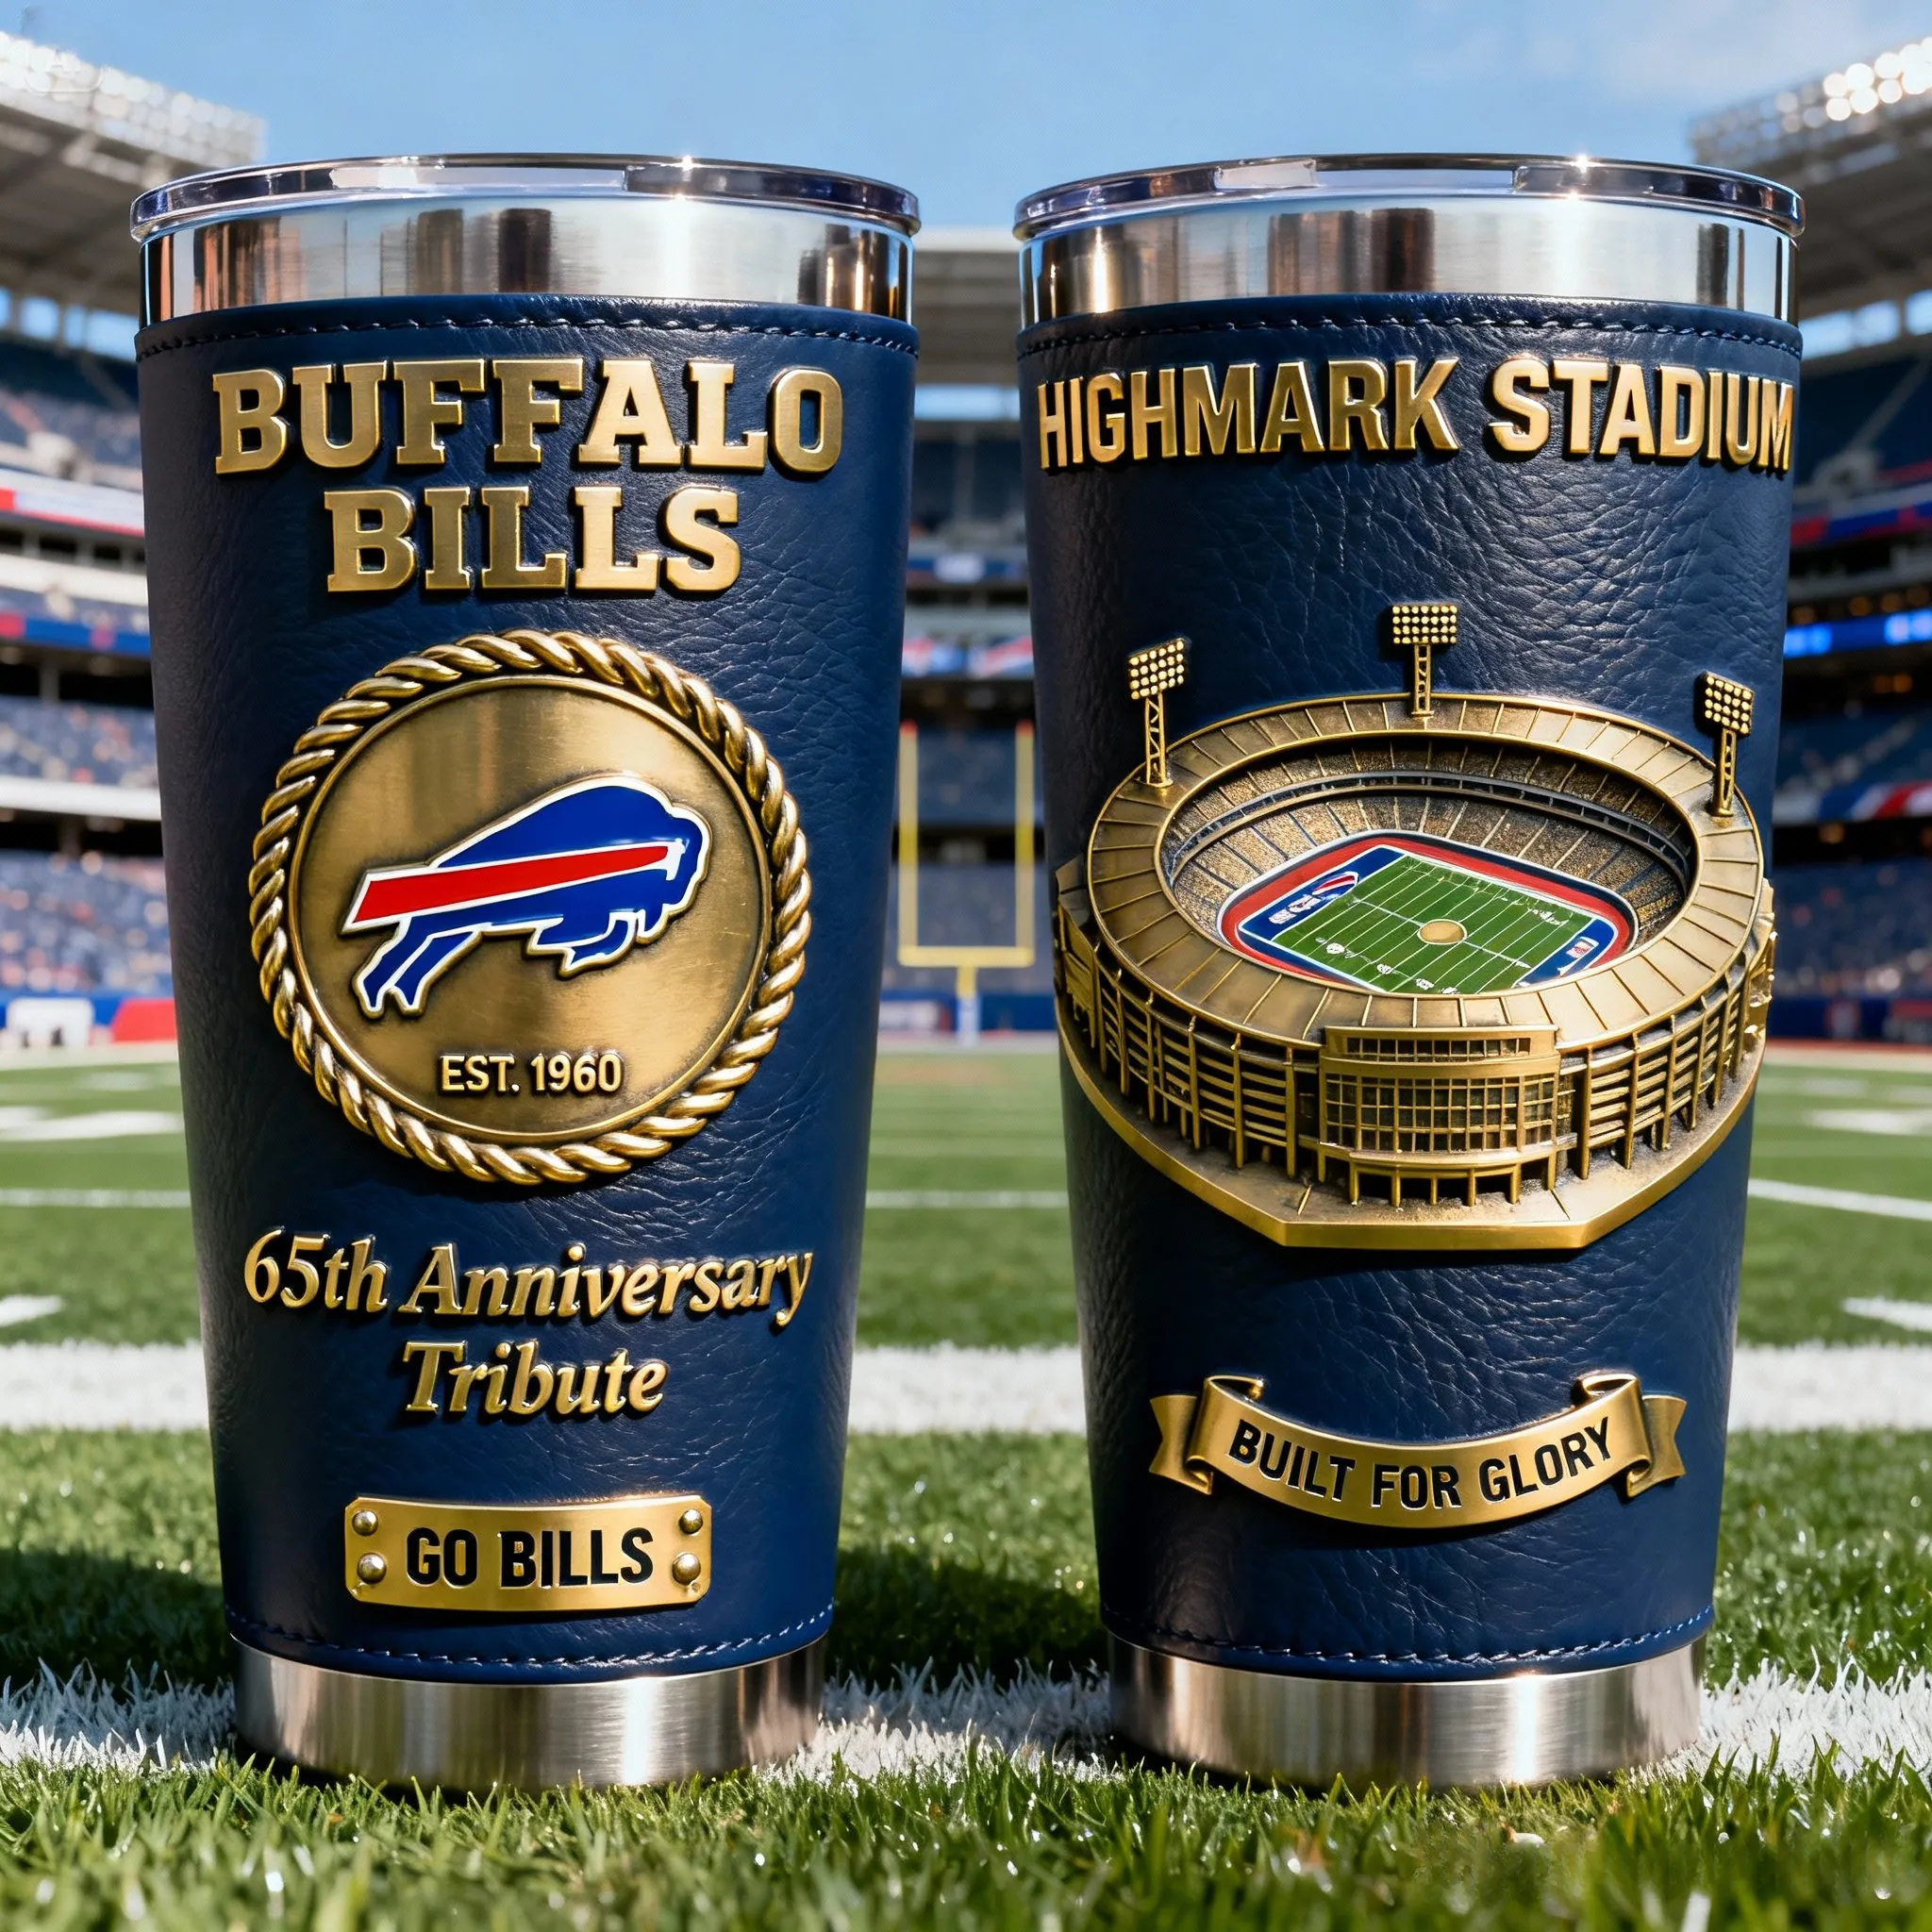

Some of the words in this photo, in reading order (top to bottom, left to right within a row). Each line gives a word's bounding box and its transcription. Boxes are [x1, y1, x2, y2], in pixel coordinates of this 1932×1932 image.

[212, 358, 844, 475] BUFFALO
[1037, 357, 1459, 469] HIGHMARK
[1487, 355, 1794, 473] STADIUM
[324, 485, 741, 593] BILLS
[441, 1054, 520, 1092] EST.
[531, 1053, 624, 1092] 1960
[244, 1226, 387, 1311] 65th
[398, 1242, 814, 1325] Anniversary
[402, 1339, 669, 1414] Tribute
[1228, 1419, 1356, 1502] BUILT
[1371, 1464, 1461, 1509] FOR
[1478, 1417, 1609, 1502] GLORY
[406, 1526, 478, 1587] GO
[499, 1526, 654, 1590] BILLS
